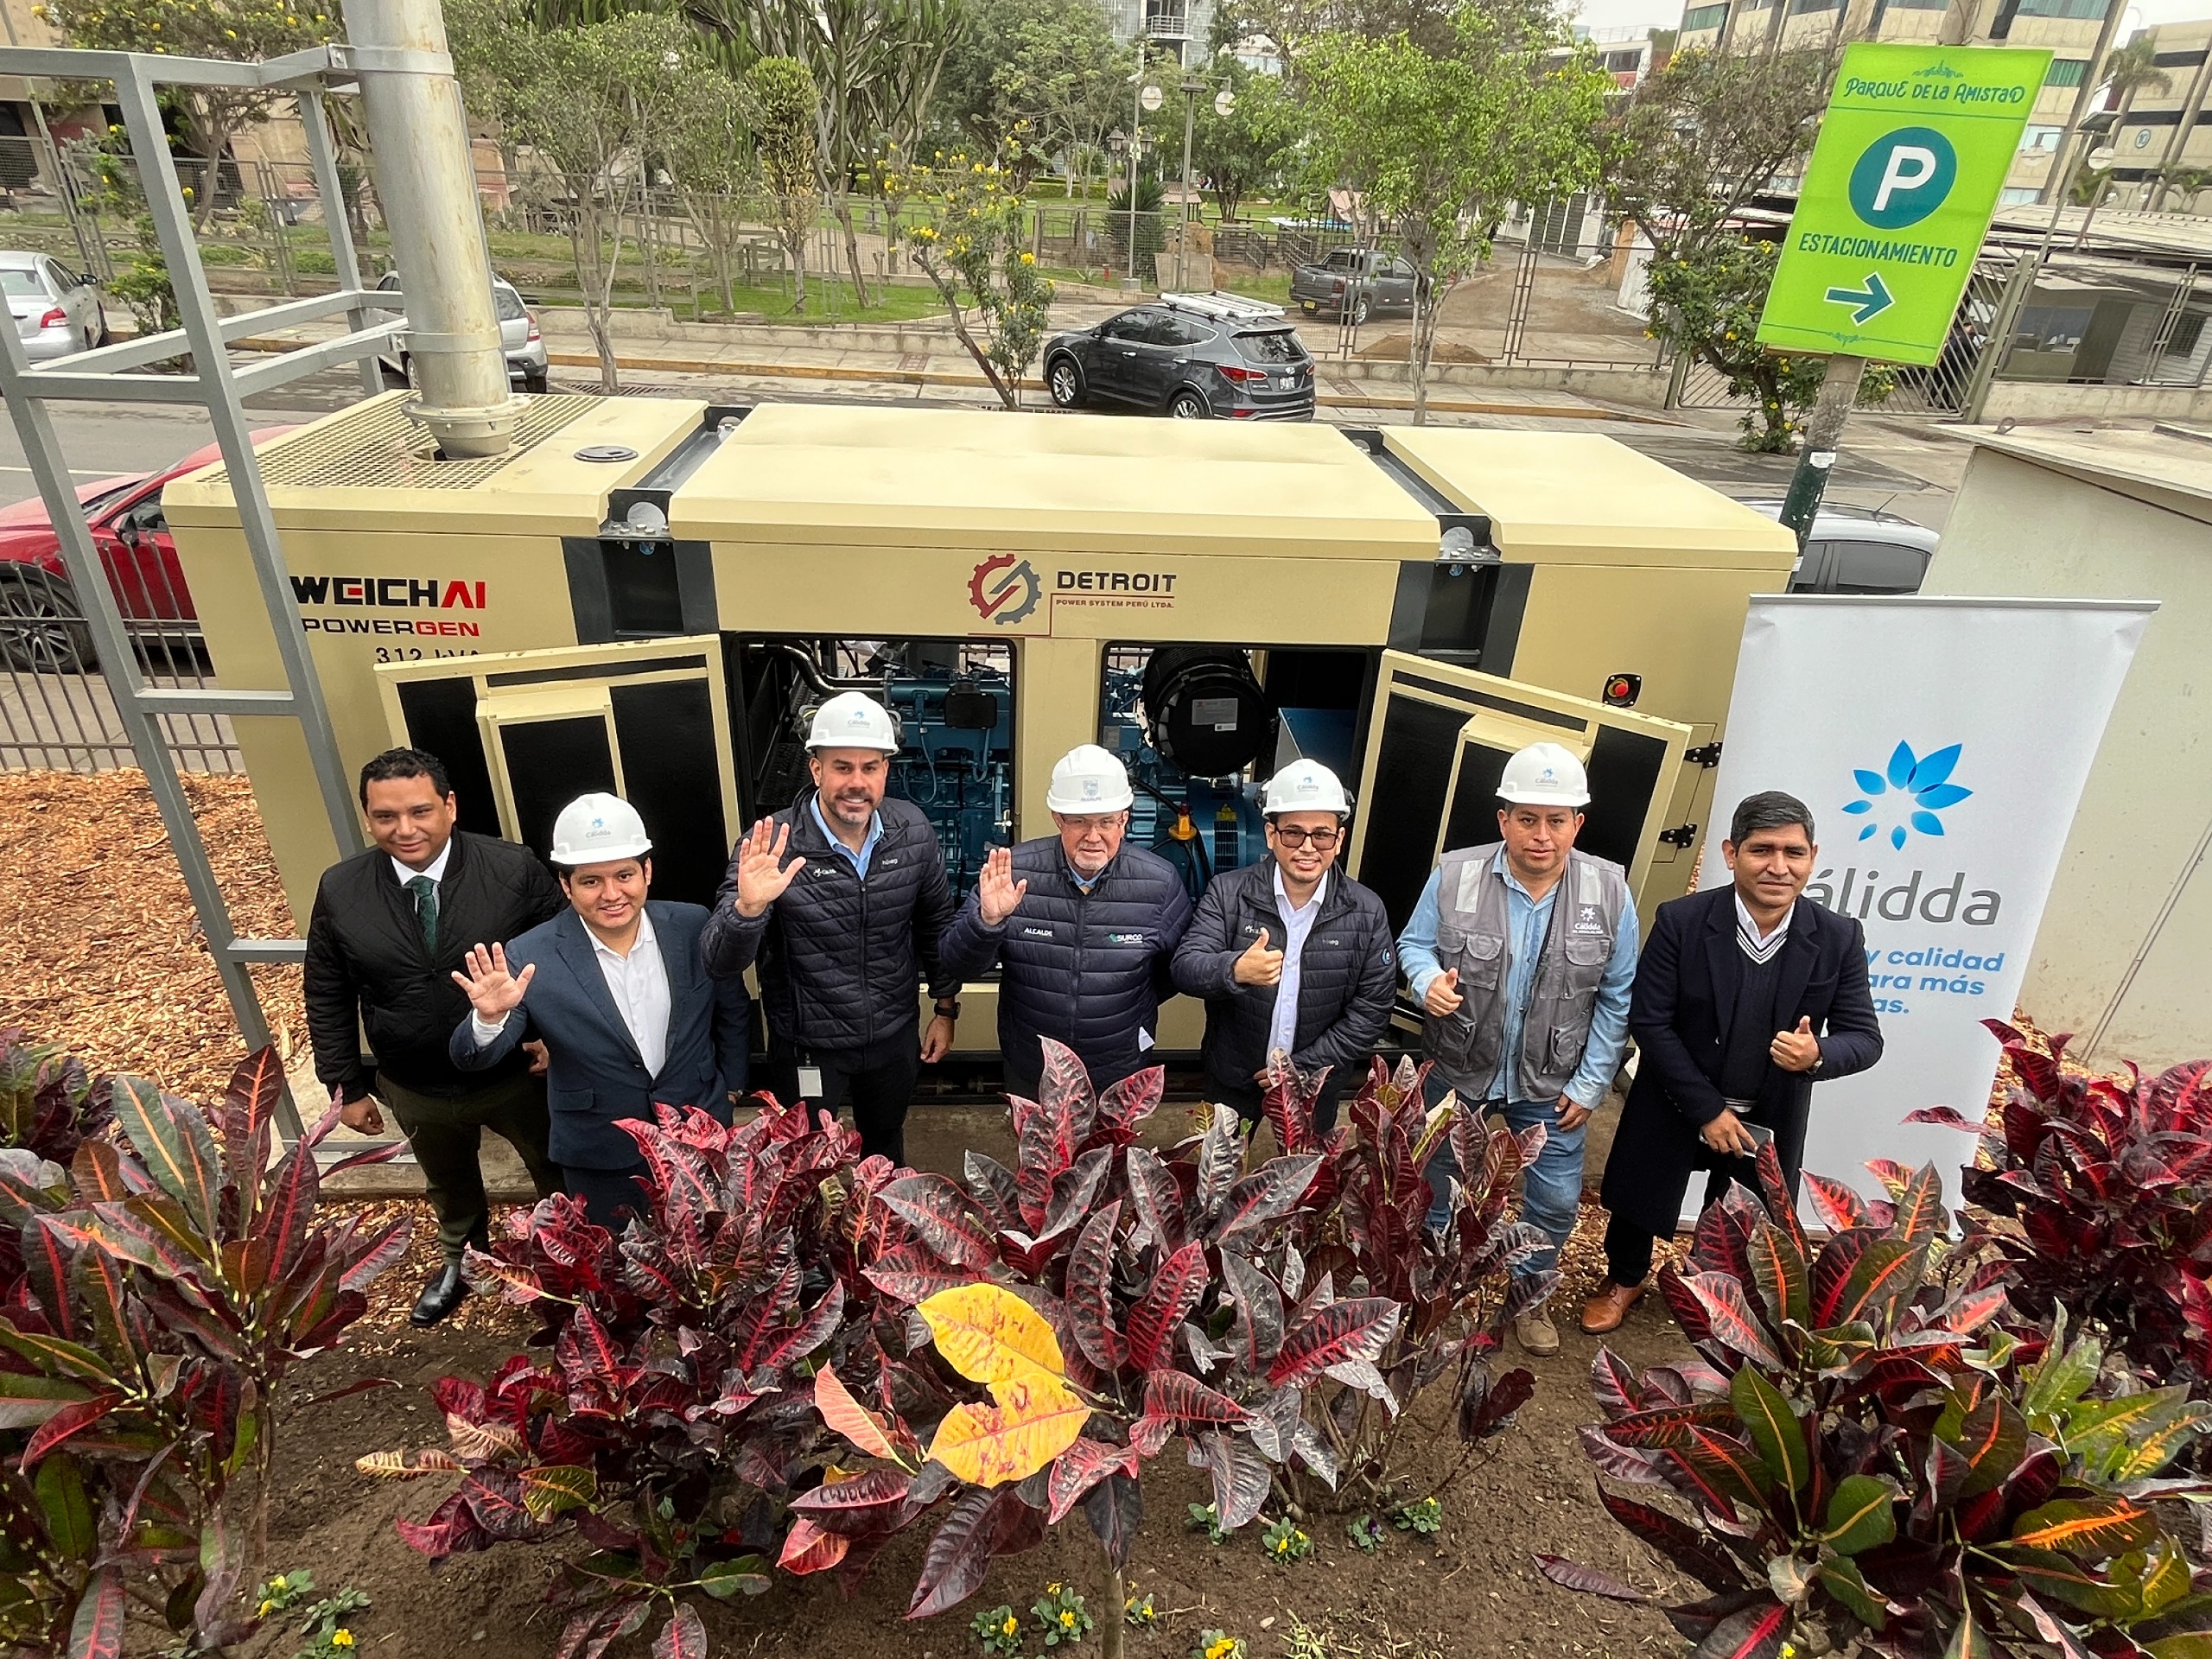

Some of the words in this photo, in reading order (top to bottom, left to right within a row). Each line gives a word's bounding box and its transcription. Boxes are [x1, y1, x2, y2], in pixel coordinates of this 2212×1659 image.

[1872, 145, 1936, 211] P
[1798, 232, 1957, 267] ESTACIONAMIENTO
[289, 576, 486, 608] WEICHAI
[1057, 571, 1177, 592] DETROIT
[302, 619, 480, 637] POWERGEN
[375, 647, 423, 664] 312
[1805, 868, 2001, 925] álidda
[1023, 926, 1053, 938] ALCALDE
[1116, 933, 1143, 942] SURCO
[1887, 947, 2005, 972] calidad
[1868, 973, 1912, 989] ara
[1919, 975, 1985, 995] más
